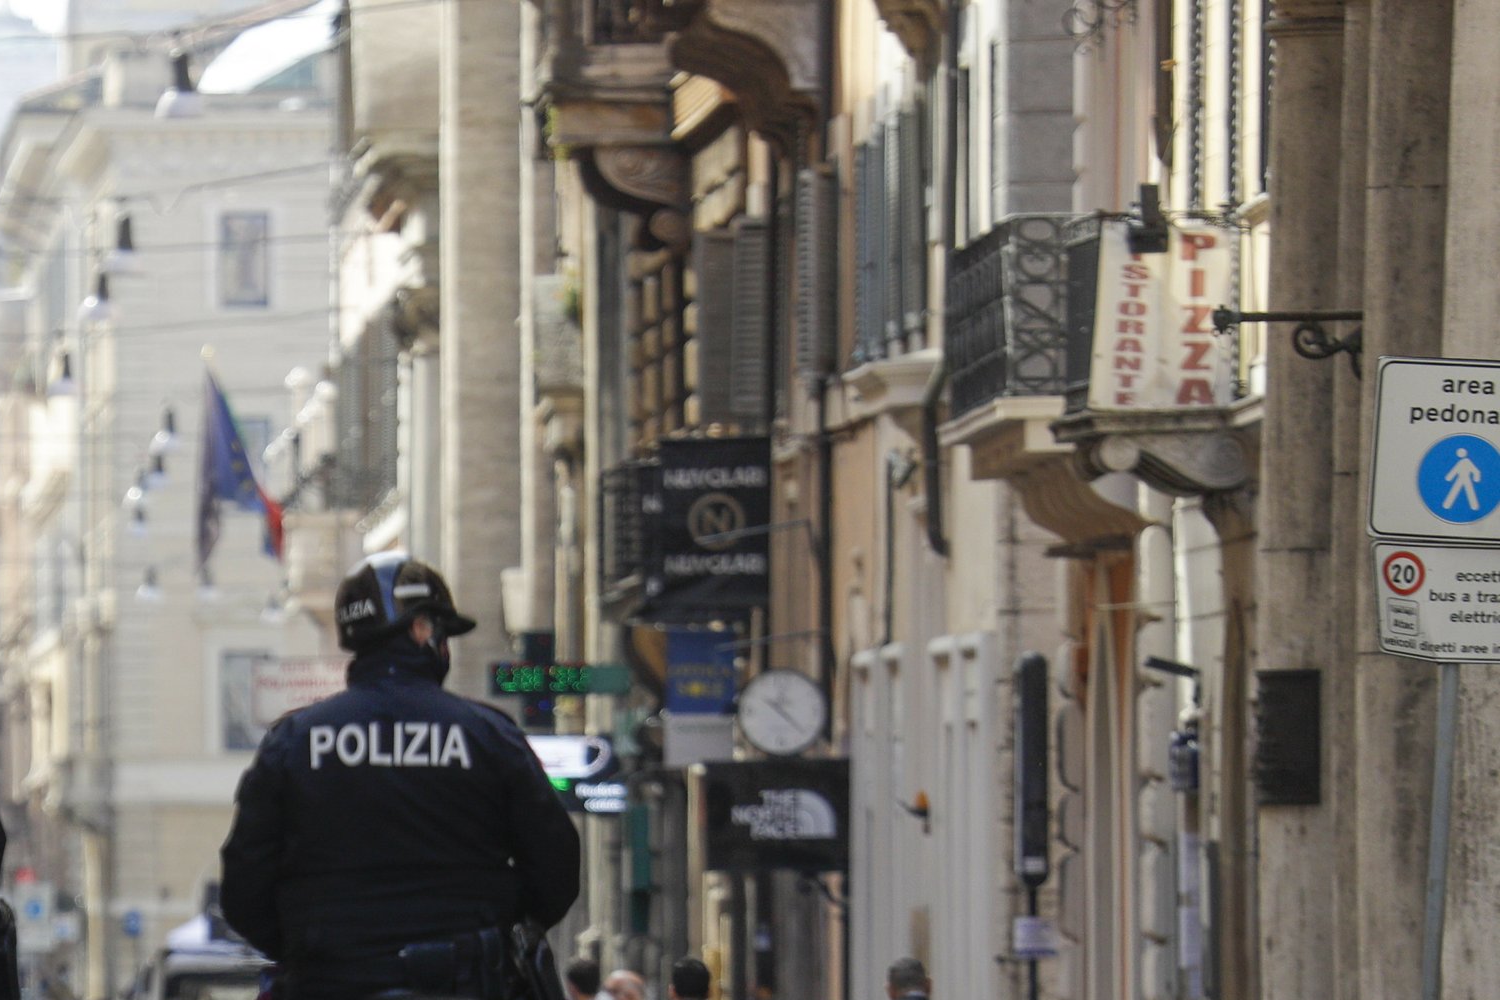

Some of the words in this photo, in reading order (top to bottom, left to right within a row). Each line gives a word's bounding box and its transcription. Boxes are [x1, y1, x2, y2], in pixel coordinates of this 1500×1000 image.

[1113, 252, 1152, 405] STORANTE
[1175, 234, 1217, 405] PIZZA
[1442, 378, 1495, 394] area
[1391, 564, 1415, 583] 20
[1429, 589, 1456, 602] bus
[1462, 592, 1470, 602] a
[1478, 590, 1500, 603] tra
[1461, 644, 1488, 654] aree
[309, 721, 471, 769] POLIZIA
